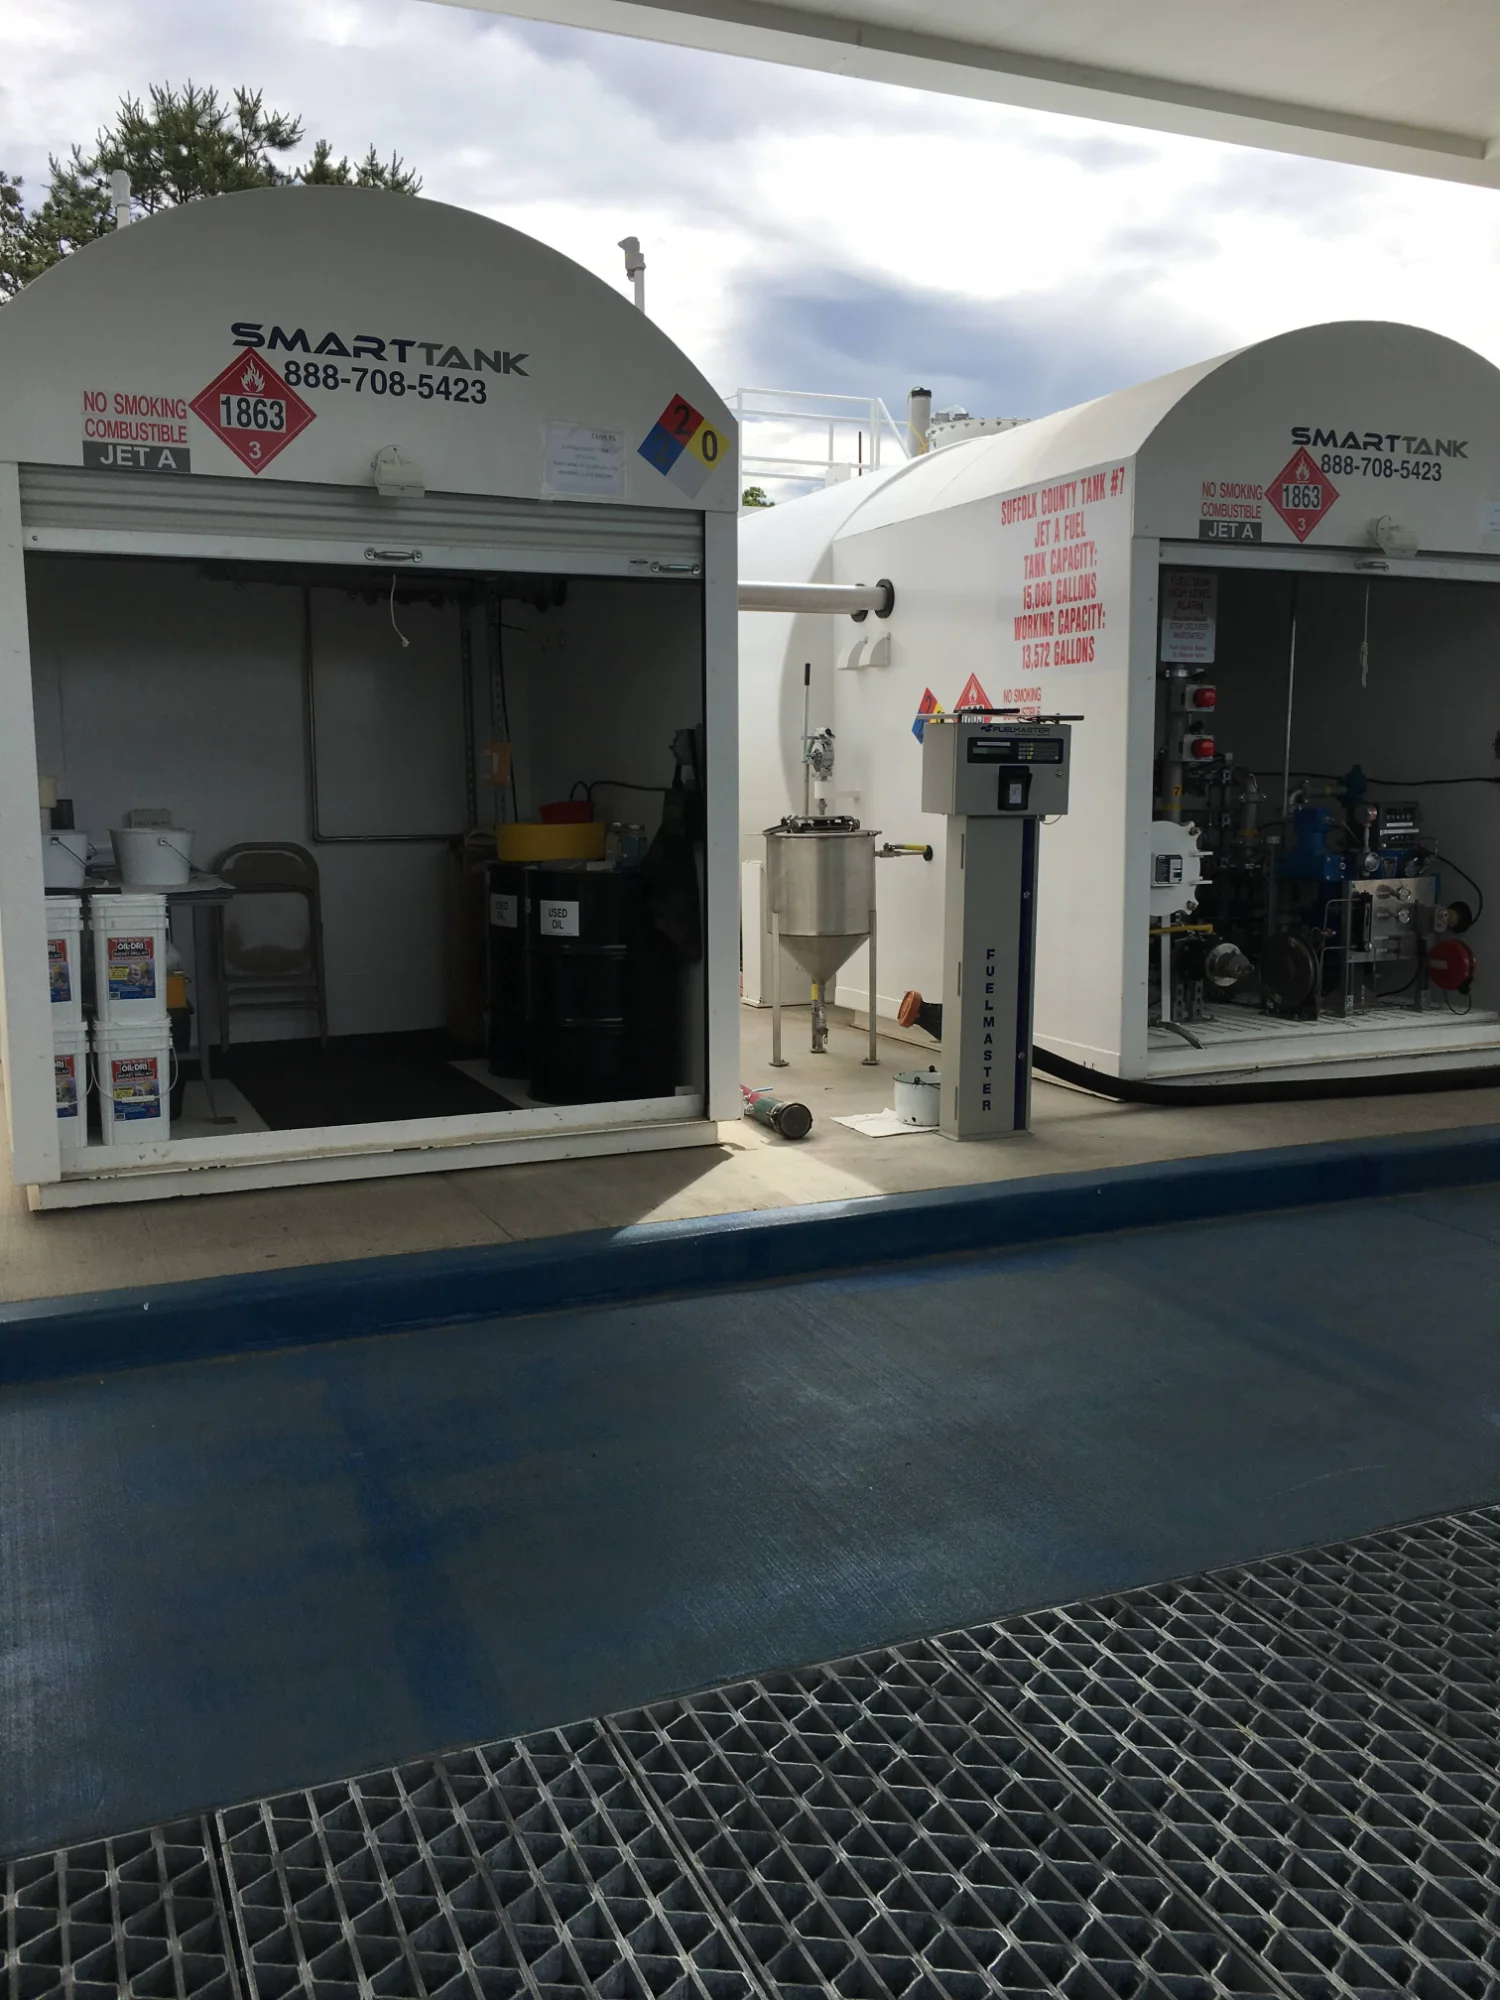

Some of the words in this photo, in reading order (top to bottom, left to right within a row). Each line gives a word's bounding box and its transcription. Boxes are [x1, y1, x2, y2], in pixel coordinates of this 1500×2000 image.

[230, 322, 531, 377] SMARTTANK
[284, 360, 487, 405] 888-708-5423
[83, 390, 108, 412] NO
[113, 393, 187, 420] SMOKING
[220, 395, 285, 431] 1863
[674, 404, 691, 435] 2
[84, 418, 188, 443] COMBUSTIBLE
[1291, 426, 1469, 459] SMARTTANK
[100, 444, 150, 467] JET
[157, 449, 177, 469] A
[248, 441, 262, 459] 3
[652, 434, 671, 463] 2
[702, 430, 718, 462] 0
[1320, 453, 1443, 482] 888-708-5423
[1001, 491, 1038, 526] SUFFOLK
[1041, 480, 1077, 516] COUNTY
[1080, 472, 1106, 506] TANK
[1110, 466, 1125, 497] #7
[1202, 482, 1217, 498] NO
[1219, 483, 1263, 501] SMOKING
[1283, 484, 1321, 509] 1863
[1201, 502, 1262, 520] COMBUSTIBLE
[1298, 518, 1306, 531] 3
[1034, 518, 1051, 548] JET
[1054, 517, 1060, 544] A
[1064, 510, 1086, 541] FUEL
[1208, 521, 1239, 538] JET
[1242, 523, 1254, 539] A
[1023, 551, 1047, 580] TANK
[1050, 540, 1098, 575] CAPACITY:
[1023, 580, 1052, 612] 15,080
[1056, 571, 1097, 605] GALLONS
[1014, 610, 1054, 641] WORKING
[1058, 602, 1106, 636] CAPACITY:
[1022, 641, 1050, 671] 13,572
[1054, 635, 1095, 667] GALLONS
[1004, 689, 1012, 704] NO
[1014, 687, 1041, 703] SMOKING
[548, 908, 568, 918] USED
[552, 919, 564, 930] OIL
[982, 949, 996, 1111] FUELMASTER
